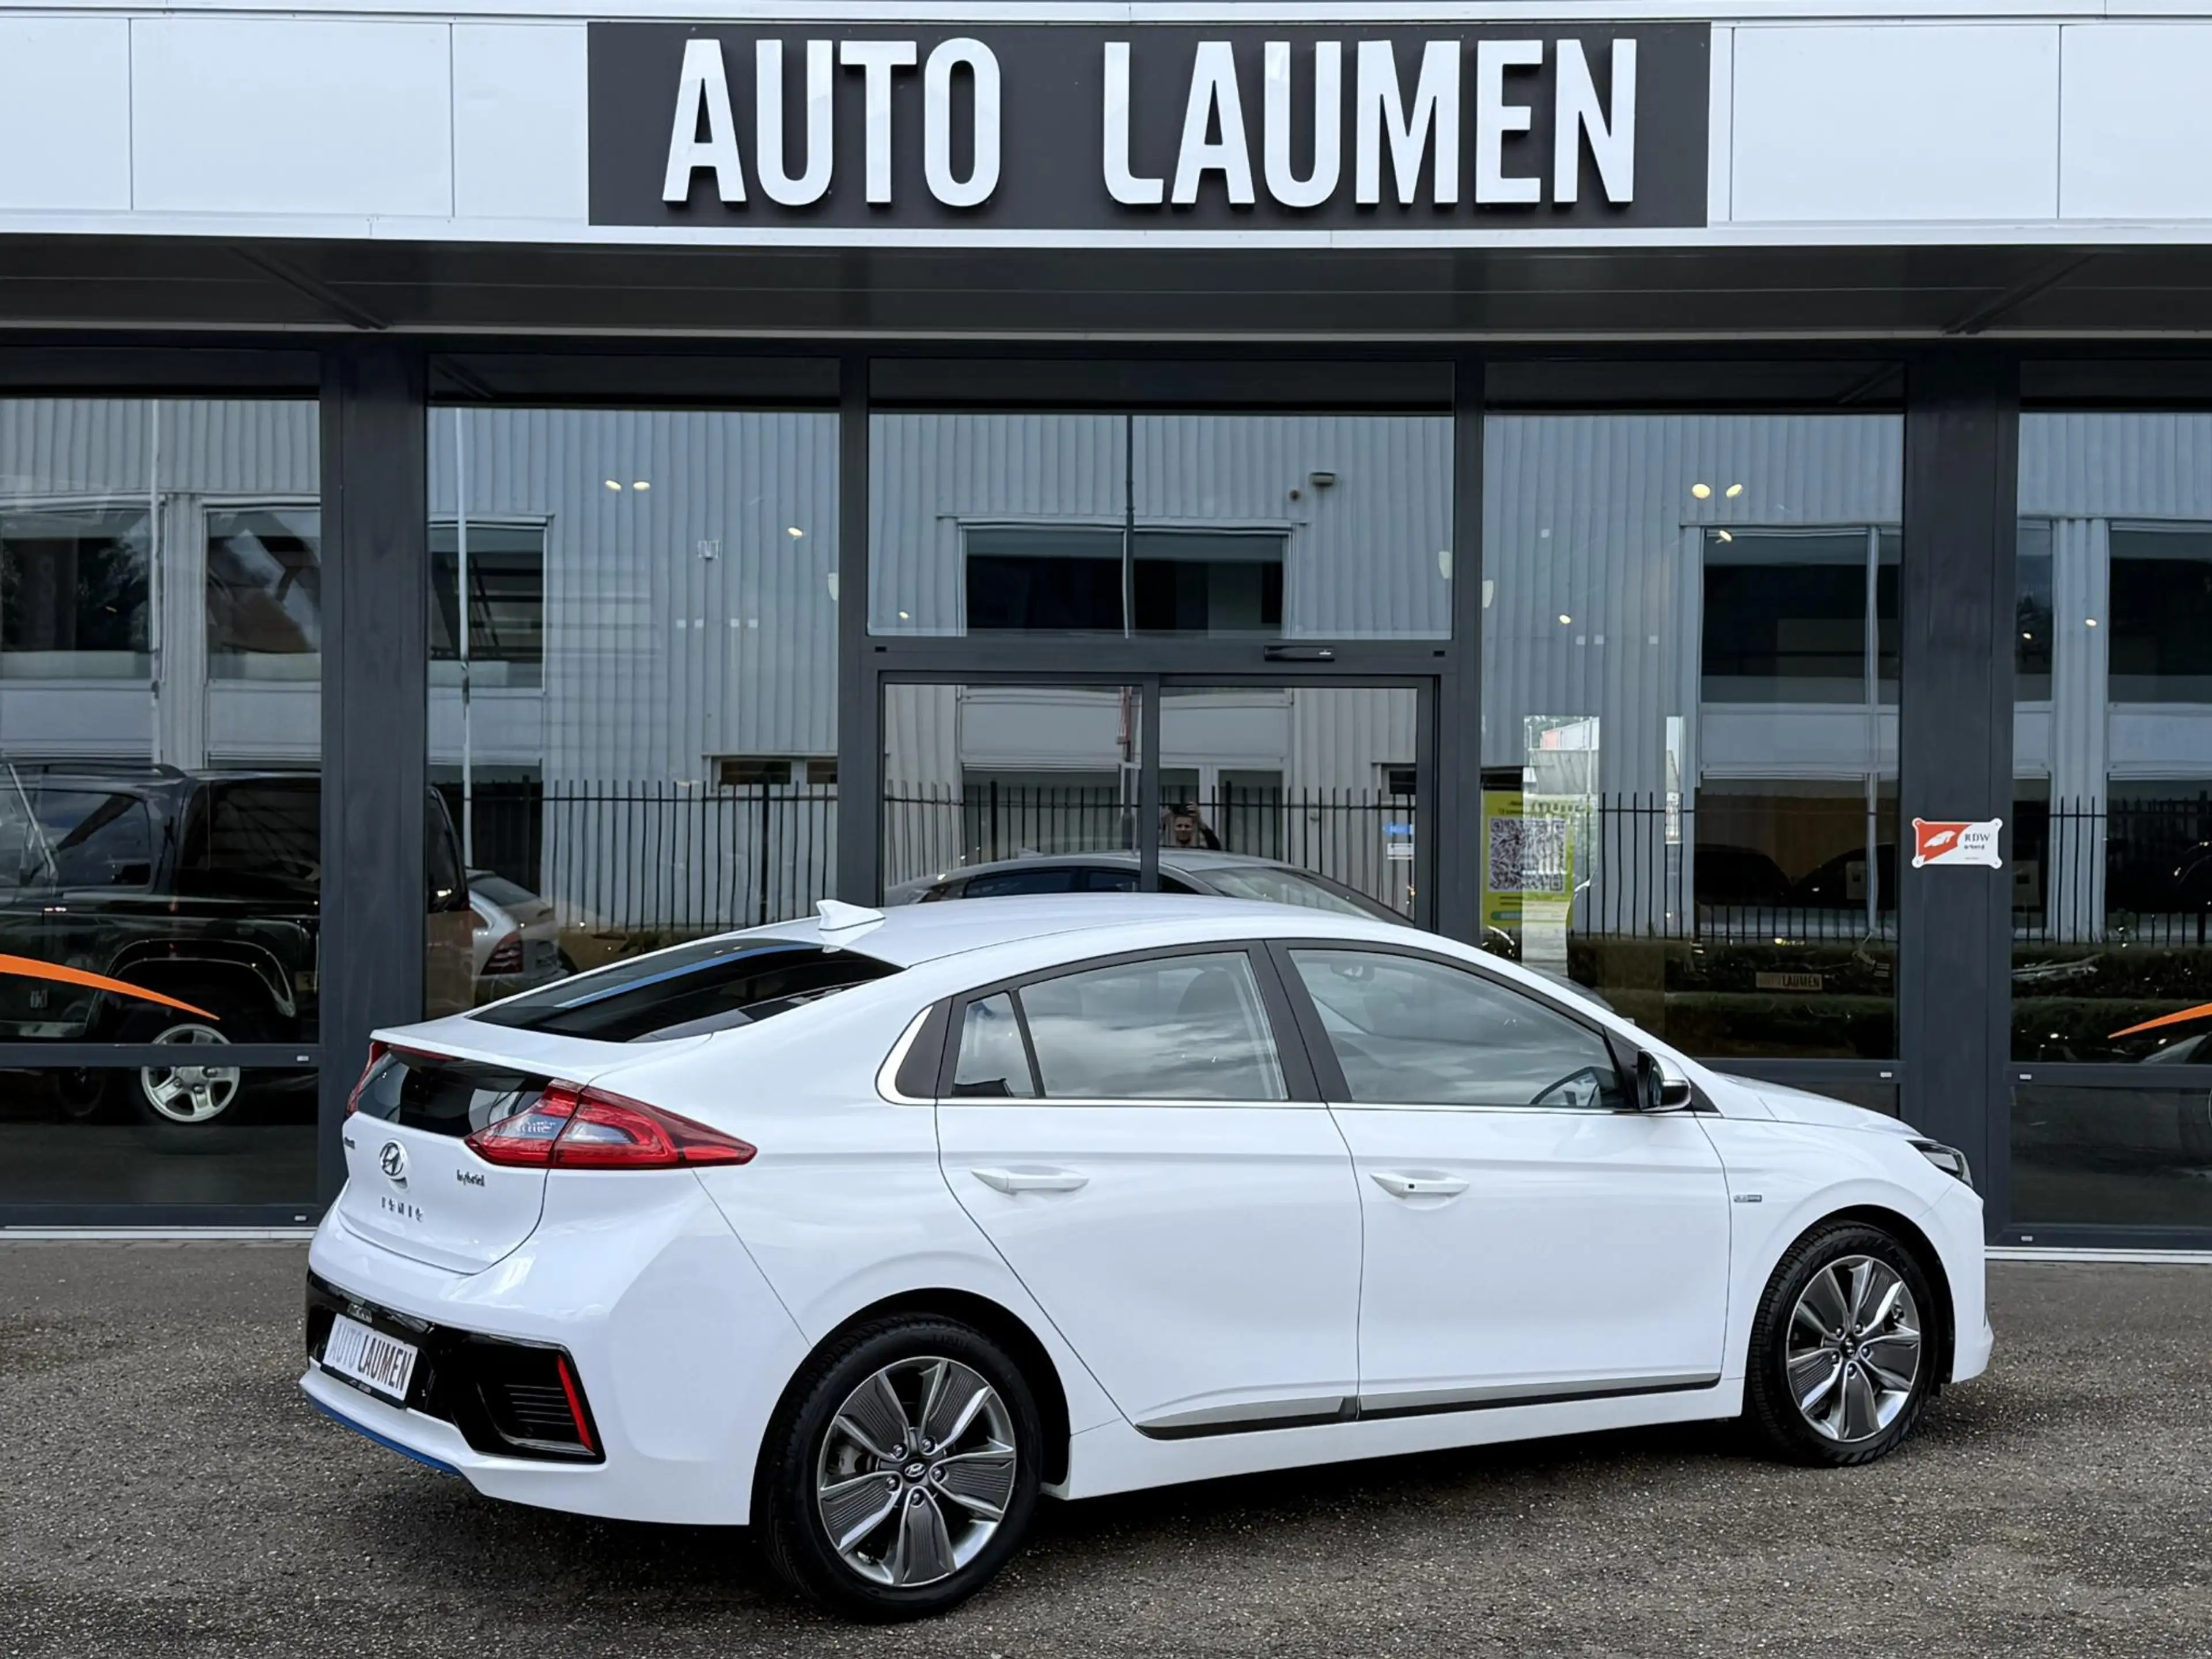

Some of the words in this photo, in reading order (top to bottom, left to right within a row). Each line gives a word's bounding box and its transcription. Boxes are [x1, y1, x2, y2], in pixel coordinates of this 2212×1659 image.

[662, 38, 1001, 207] AUTO
[1104, 39, 1637, 207] LAUMEN
[1964, 833, 1990, 842] RDW
[327, 1322, 362, 1369] AUTO
[358, 1334, 412, 1392] LAUMEN
